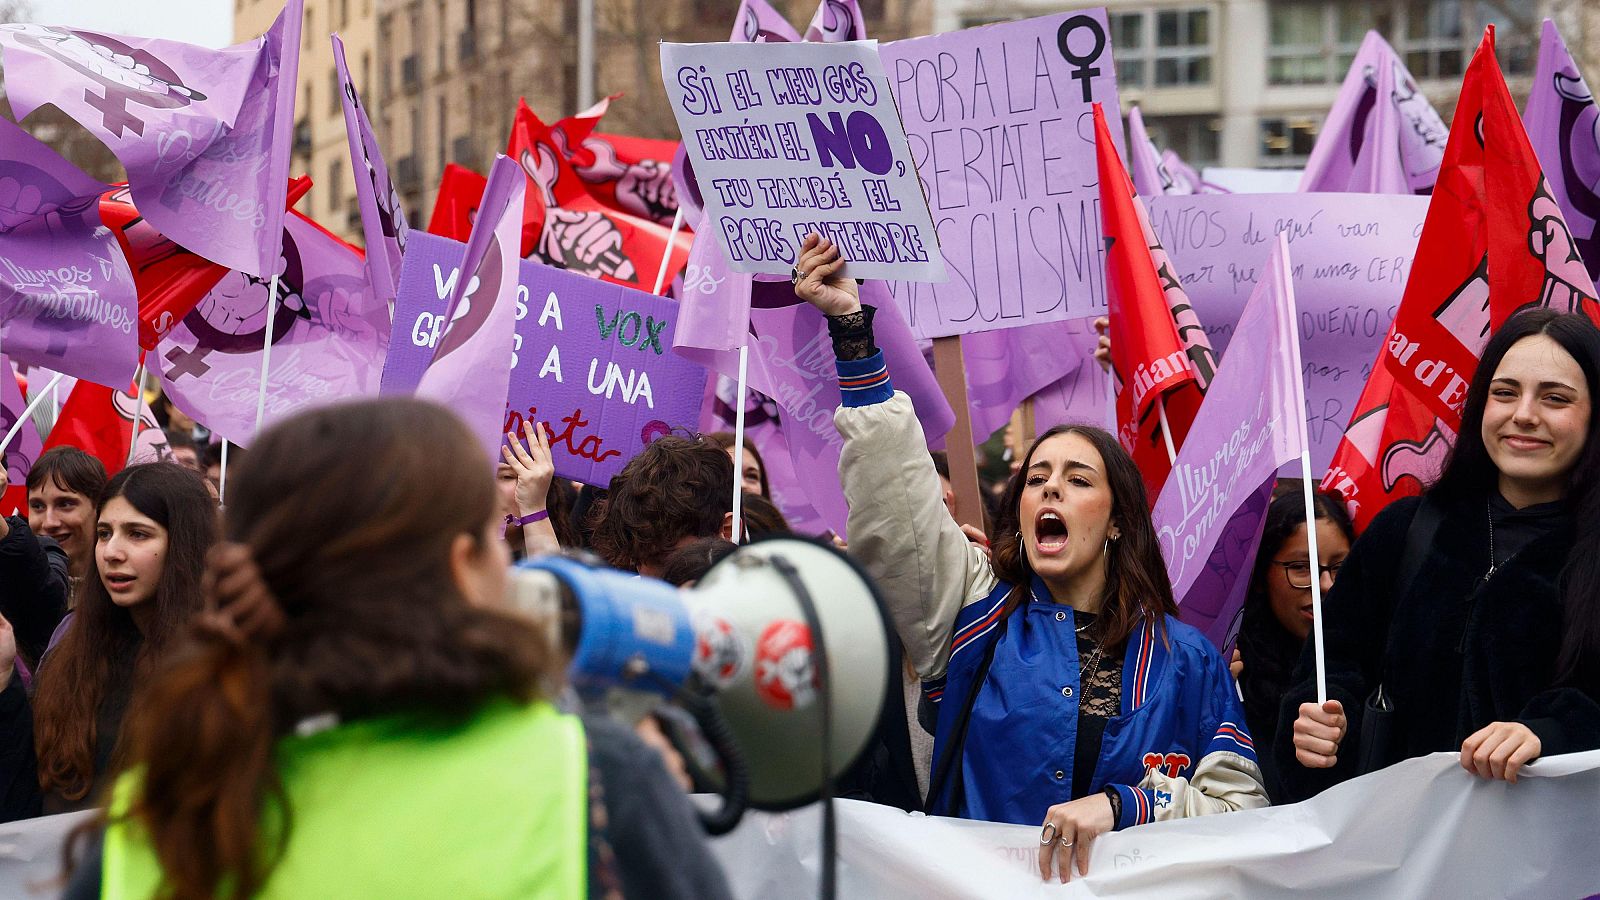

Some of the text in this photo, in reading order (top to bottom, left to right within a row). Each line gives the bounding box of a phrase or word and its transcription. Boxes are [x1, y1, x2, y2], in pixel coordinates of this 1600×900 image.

[726, 69, 762, 110] EL
[766, 67, 822, 105] MEU
[823, 61, 877, 106] GOS
[895, 36, 1059, 123] POR A LA
[696, 110, 906, 177] ENTÉN EL NO,
[712, 172, 901, 212] TU TAMBÉ EL
[720, 216, 796, 264] POTS
[1243, 212, 1266, 245] de
[1338, 222, 1379, 238] van
[1367, 256, 1408, 283] CER
[538, 291, 563, 331] A
[595, 303, 668, 355] VOX
[538, 344, 564, 383] A
[587, 357, 655, 409] UNA
